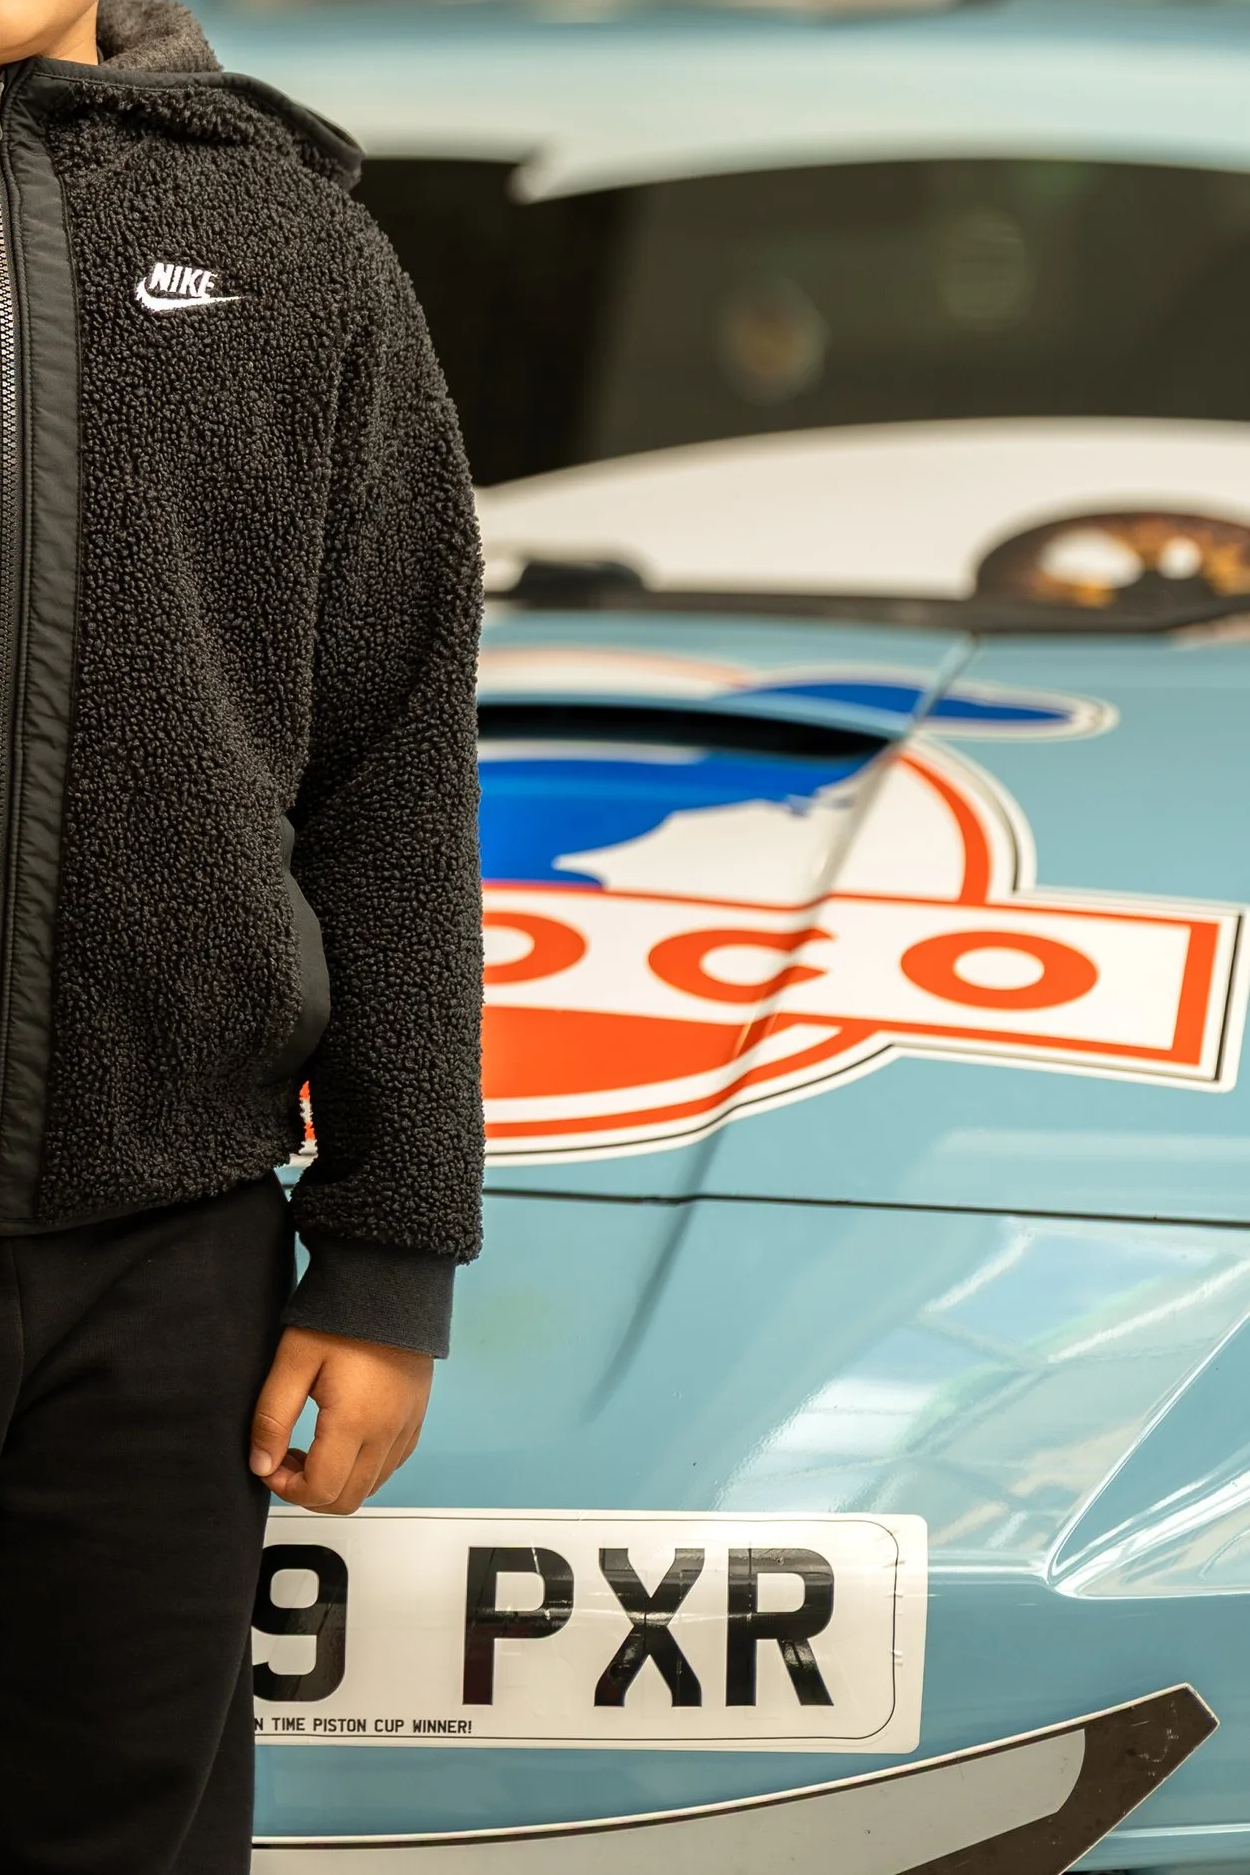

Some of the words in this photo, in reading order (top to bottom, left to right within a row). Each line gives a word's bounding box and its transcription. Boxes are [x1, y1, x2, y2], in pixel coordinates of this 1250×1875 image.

[149, 262, 218, 298] NIKE
[251, 1544, 349, 1702] 9
[462, 1546, 835, 1708] PXR
[271, 1717, 306, 1732] TIME
[313, 1718, 367, 1733] PISTON
[374, 1719, 405, 1733] CUP
[412, 1719, 473, 1734] WINNER!
